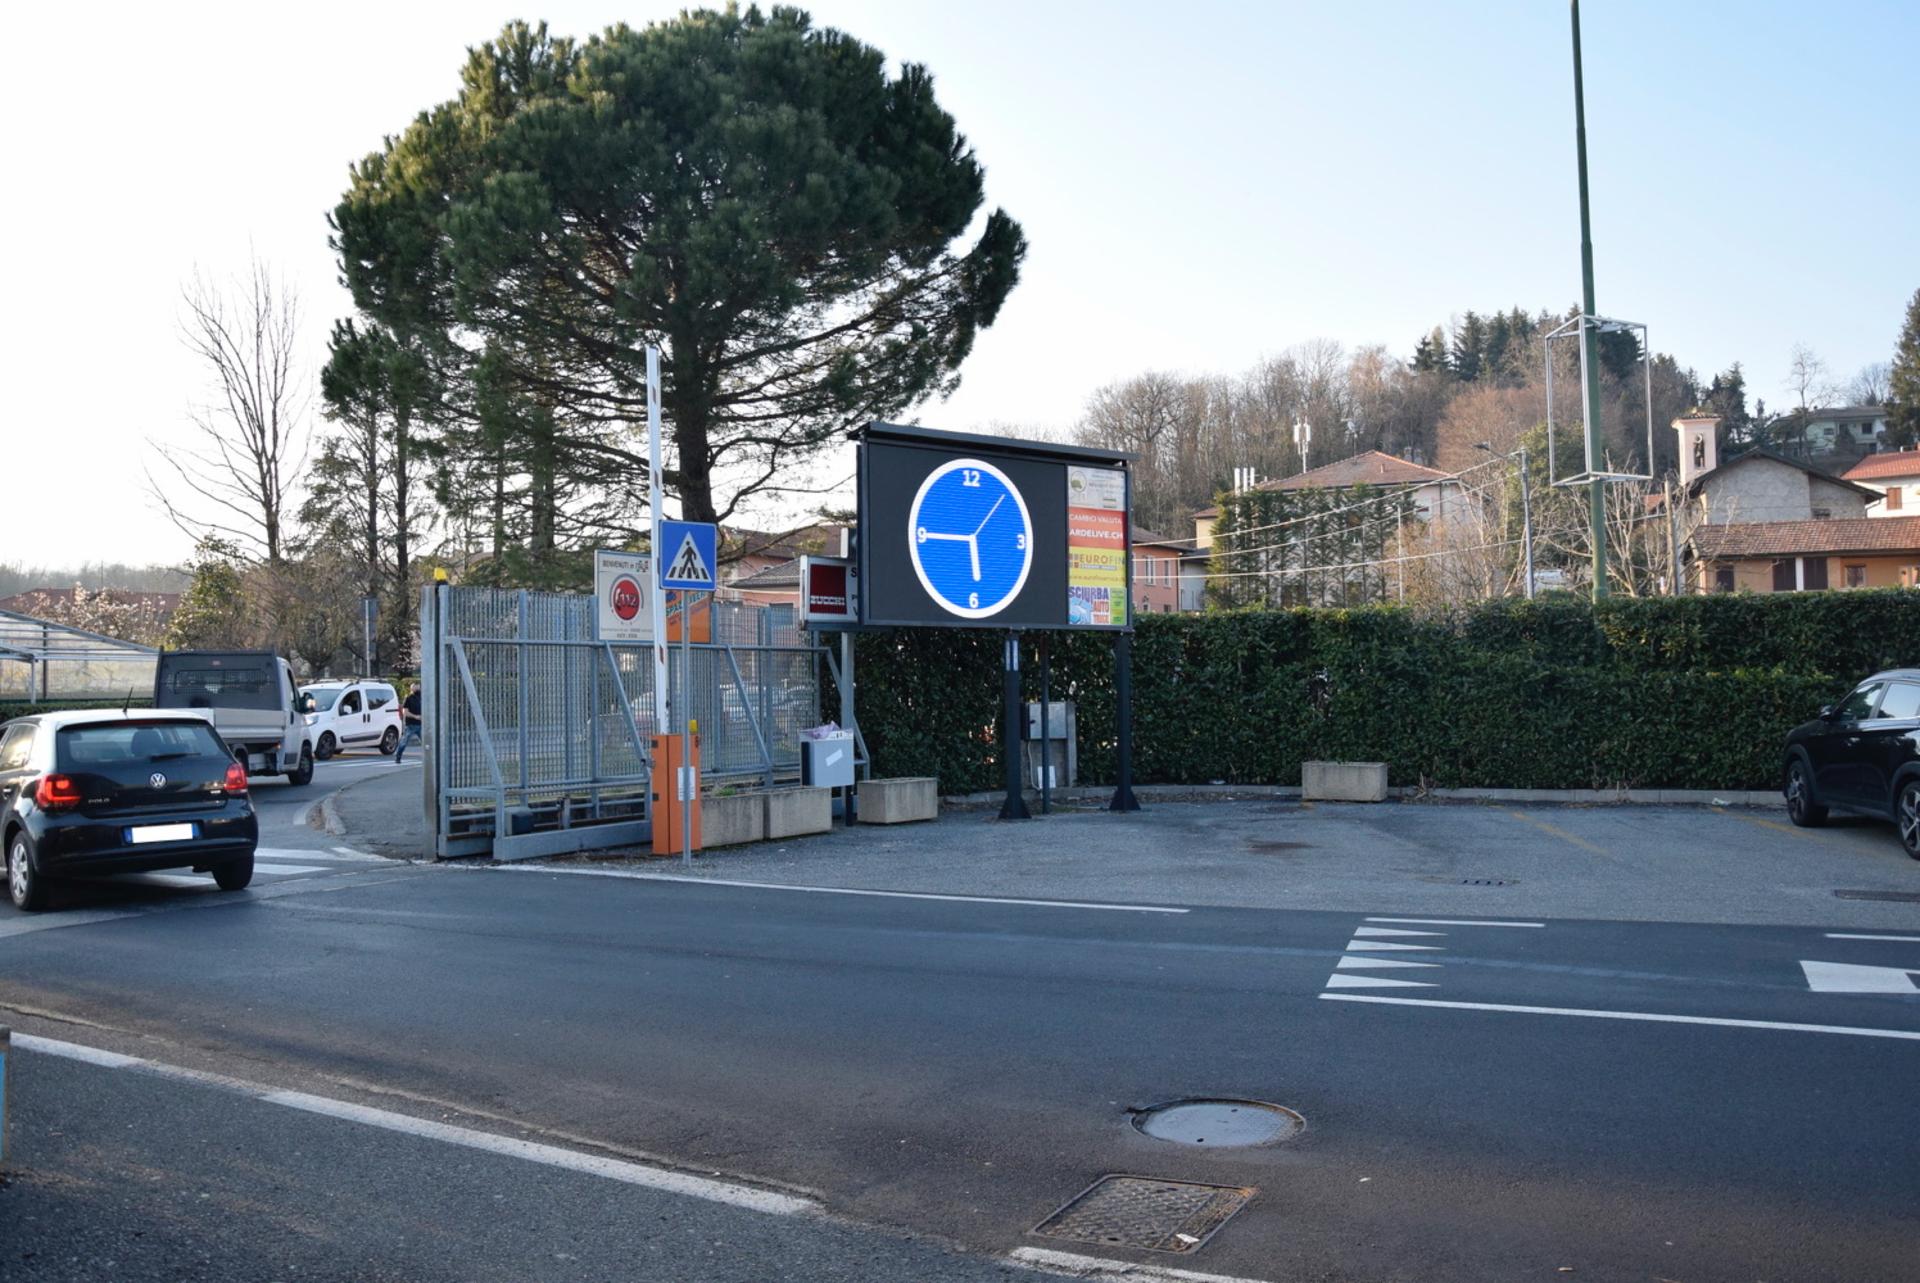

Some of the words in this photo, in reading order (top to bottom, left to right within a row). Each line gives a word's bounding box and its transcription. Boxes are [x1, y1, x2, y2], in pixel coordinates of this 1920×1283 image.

[962, 470, 981, 487] 12
[917, 527, 927, 543] 9
[1016, 534, 1026, 550] 3
[968, 592, 979, 608] 6
